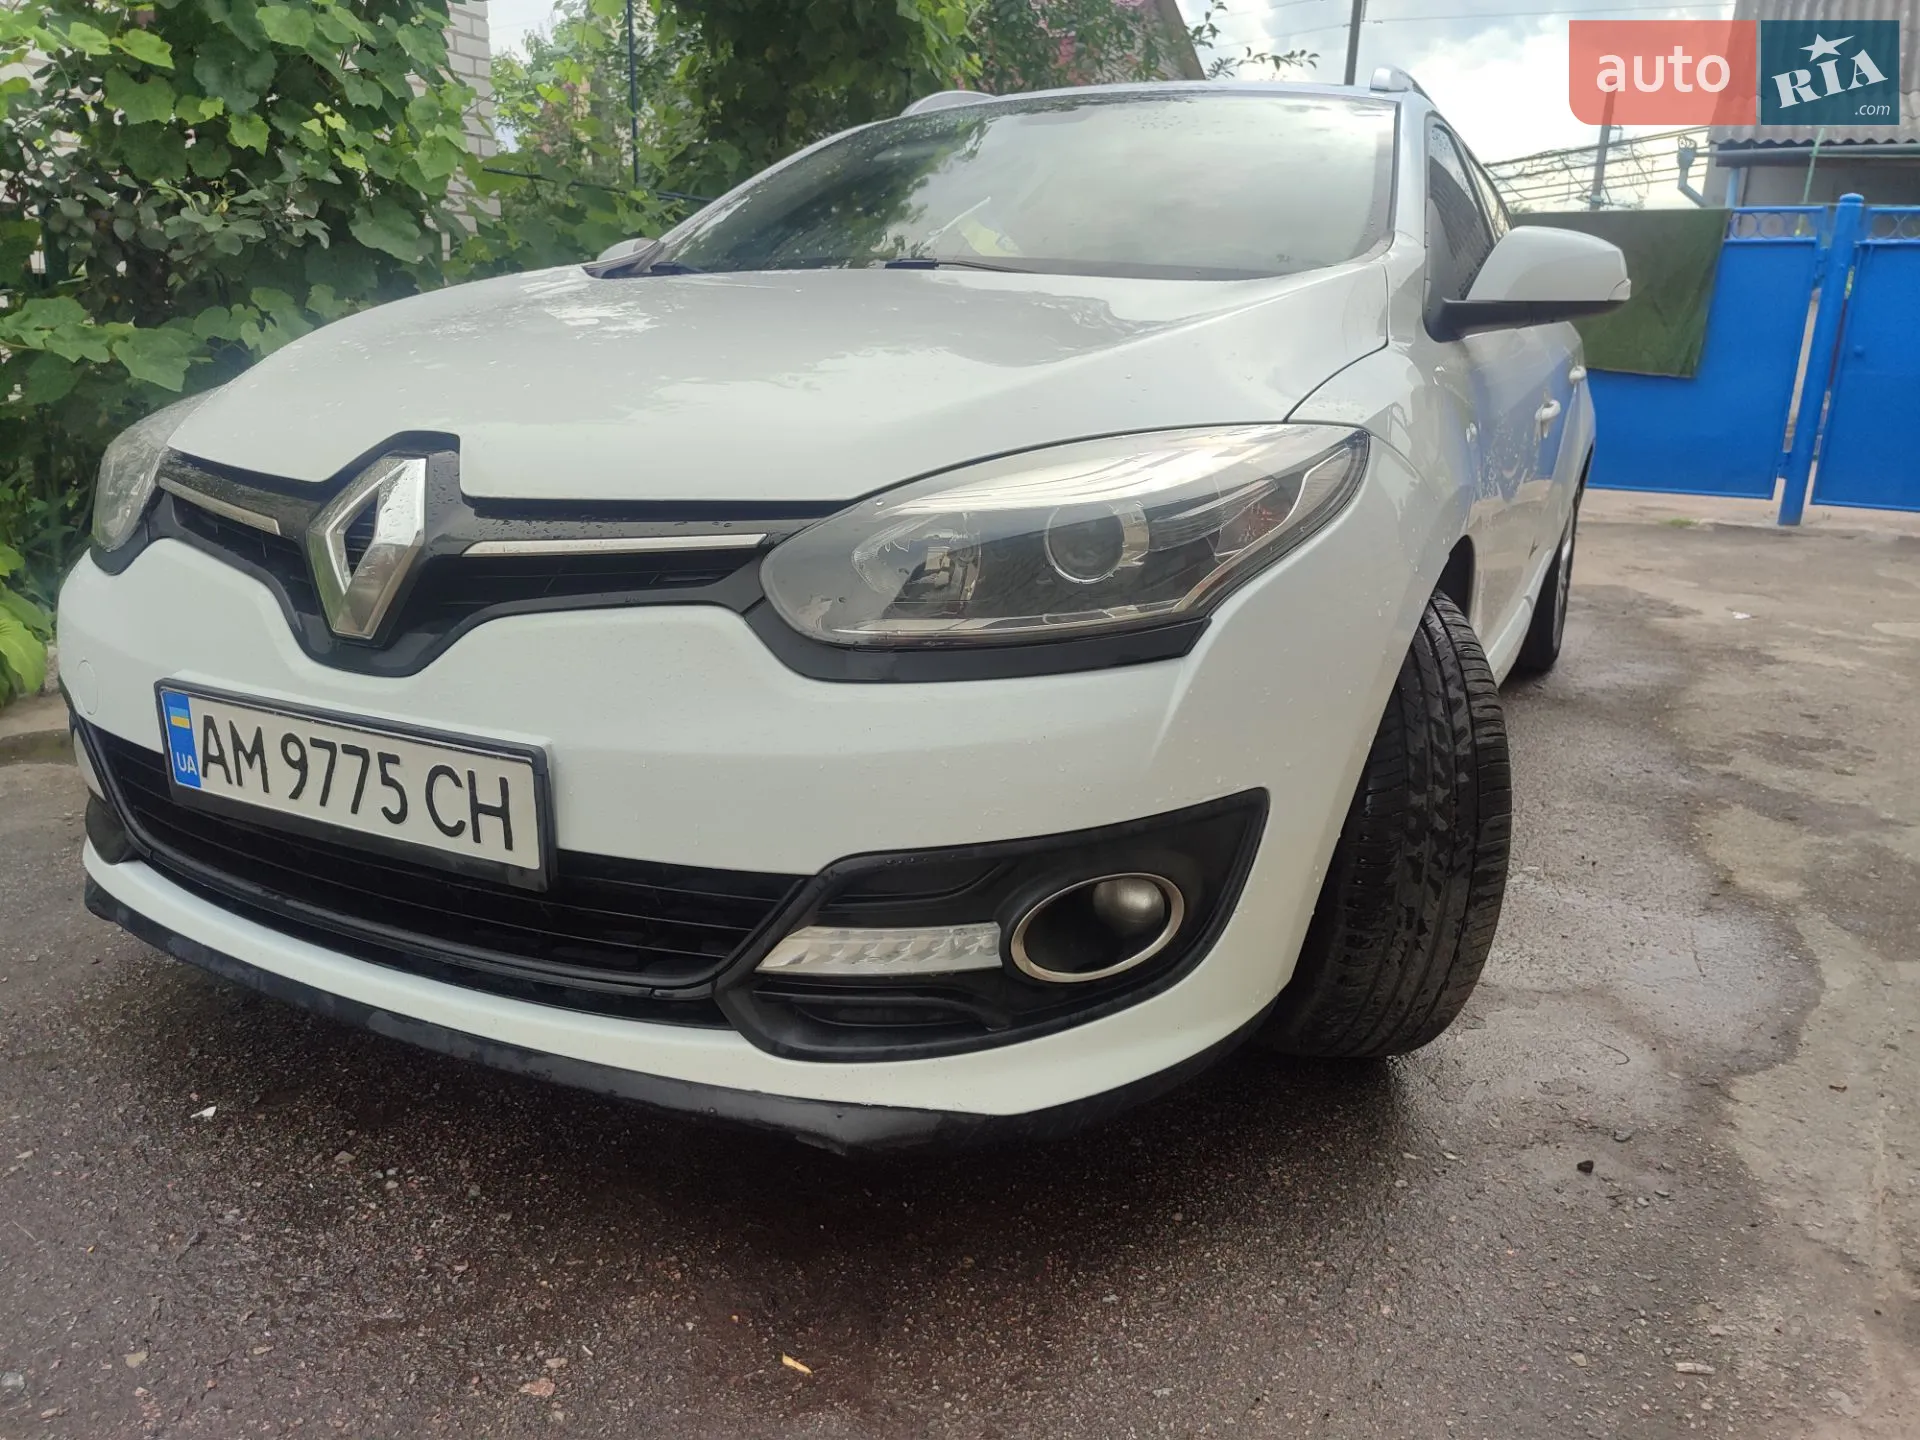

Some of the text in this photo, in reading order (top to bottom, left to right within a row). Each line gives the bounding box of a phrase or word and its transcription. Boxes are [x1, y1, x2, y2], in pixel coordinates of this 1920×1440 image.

[176, 752, 198, 776] UA
[202, 715, 513, 850] AM 9775 CH
